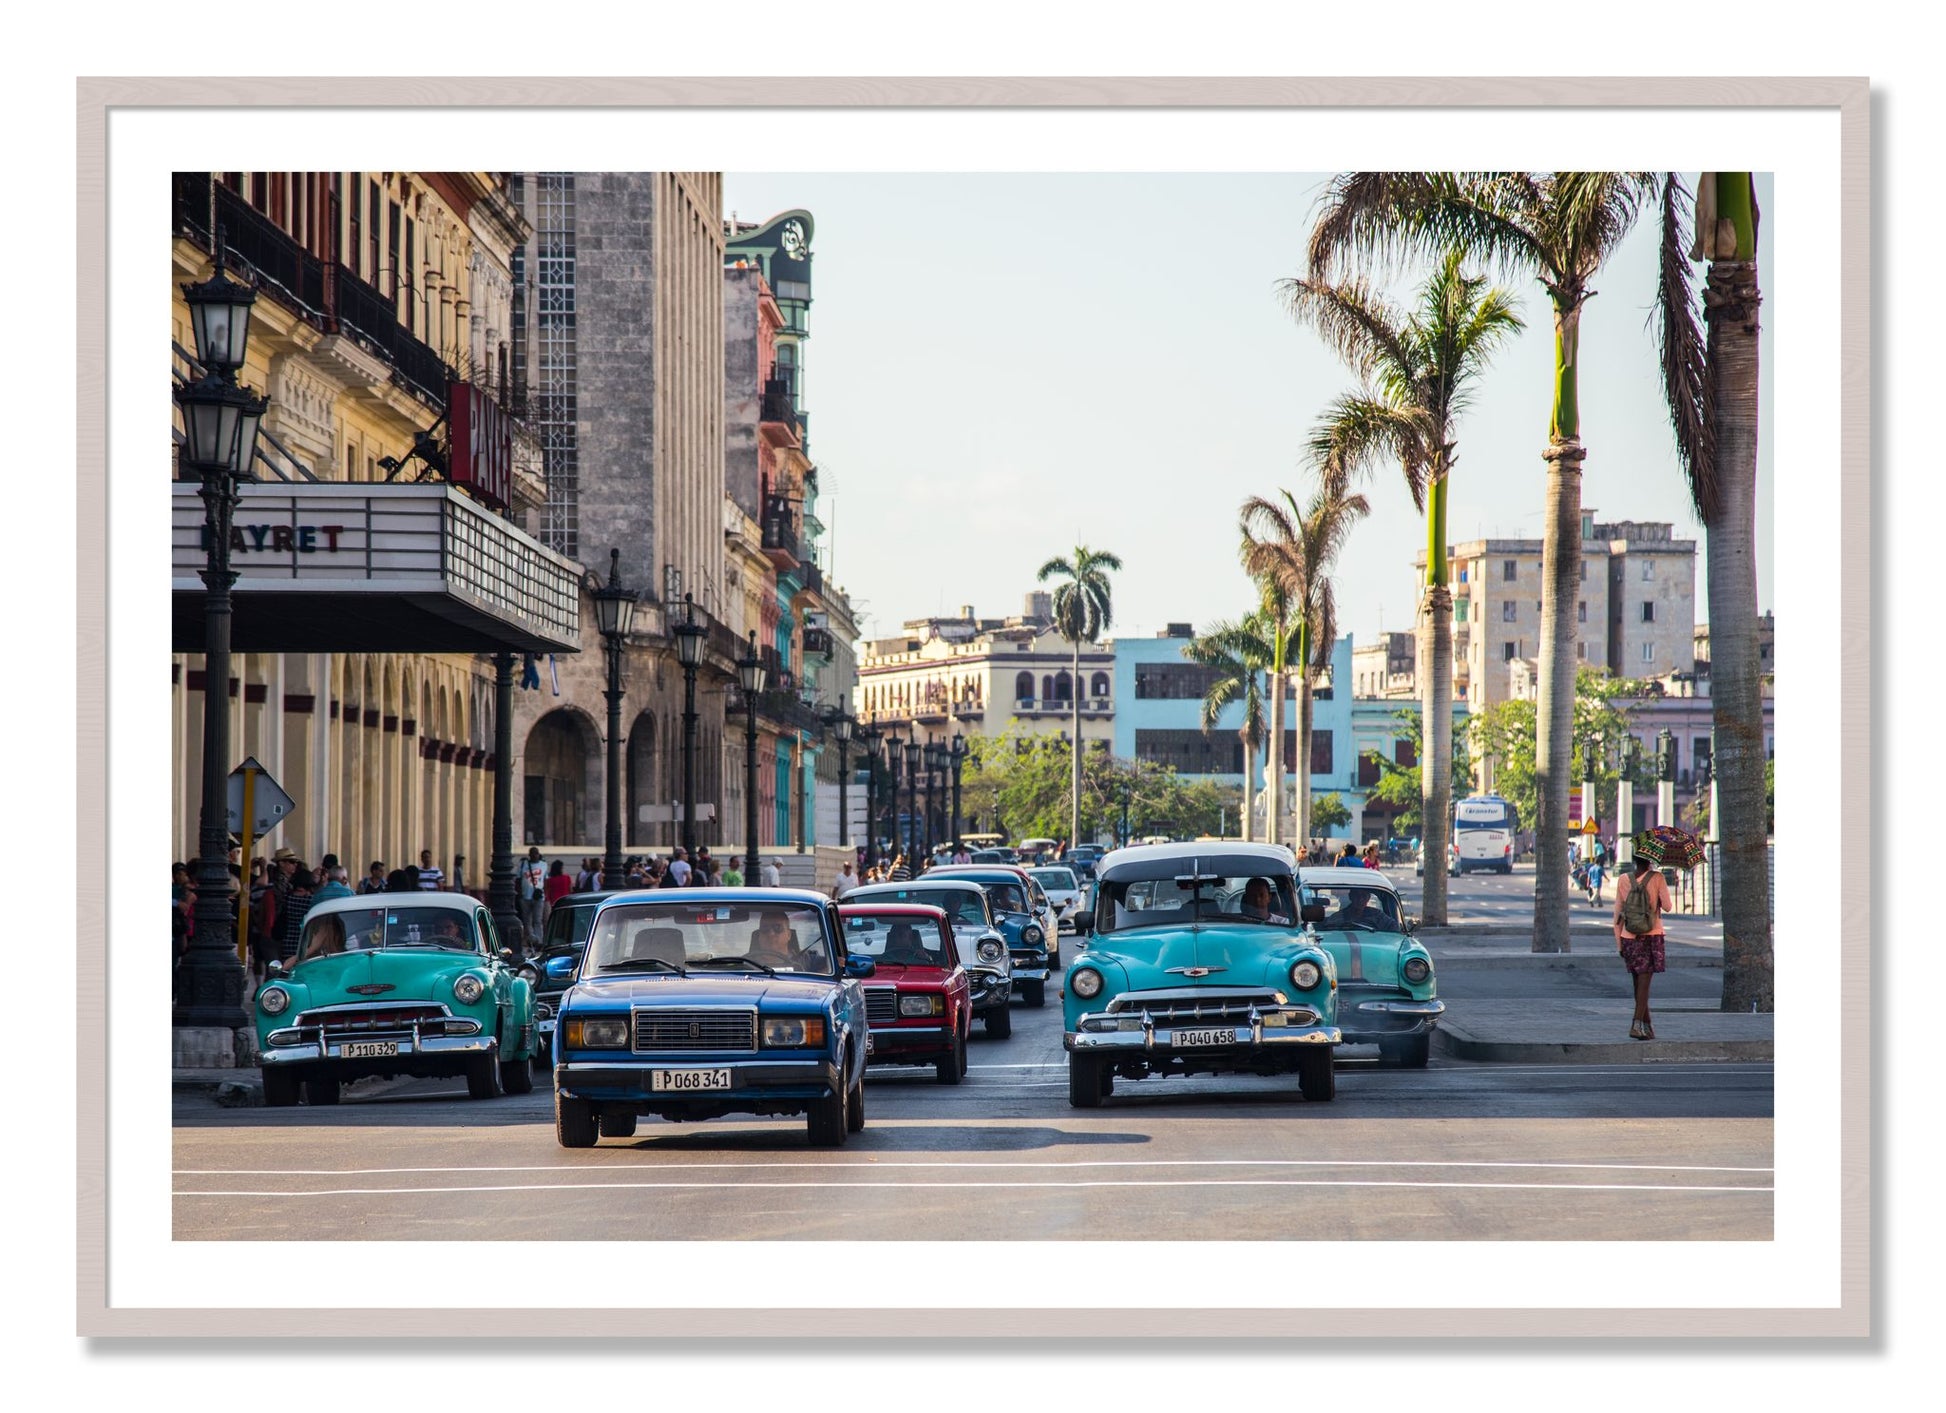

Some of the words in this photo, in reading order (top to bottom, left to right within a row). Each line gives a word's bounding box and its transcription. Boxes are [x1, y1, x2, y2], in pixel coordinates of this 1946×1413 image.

[1189, 1032, 1211, 1045] 040
[1213, 1030, 1234, 1044] 658
[356, 1045, 376, 1057] 110
[377, 1043, 396, 1056] 329
[663, 1071, 672, 1089] P
[674, 1073, 700, 1088] 068
[702, 1071, 729, 1087] 341
